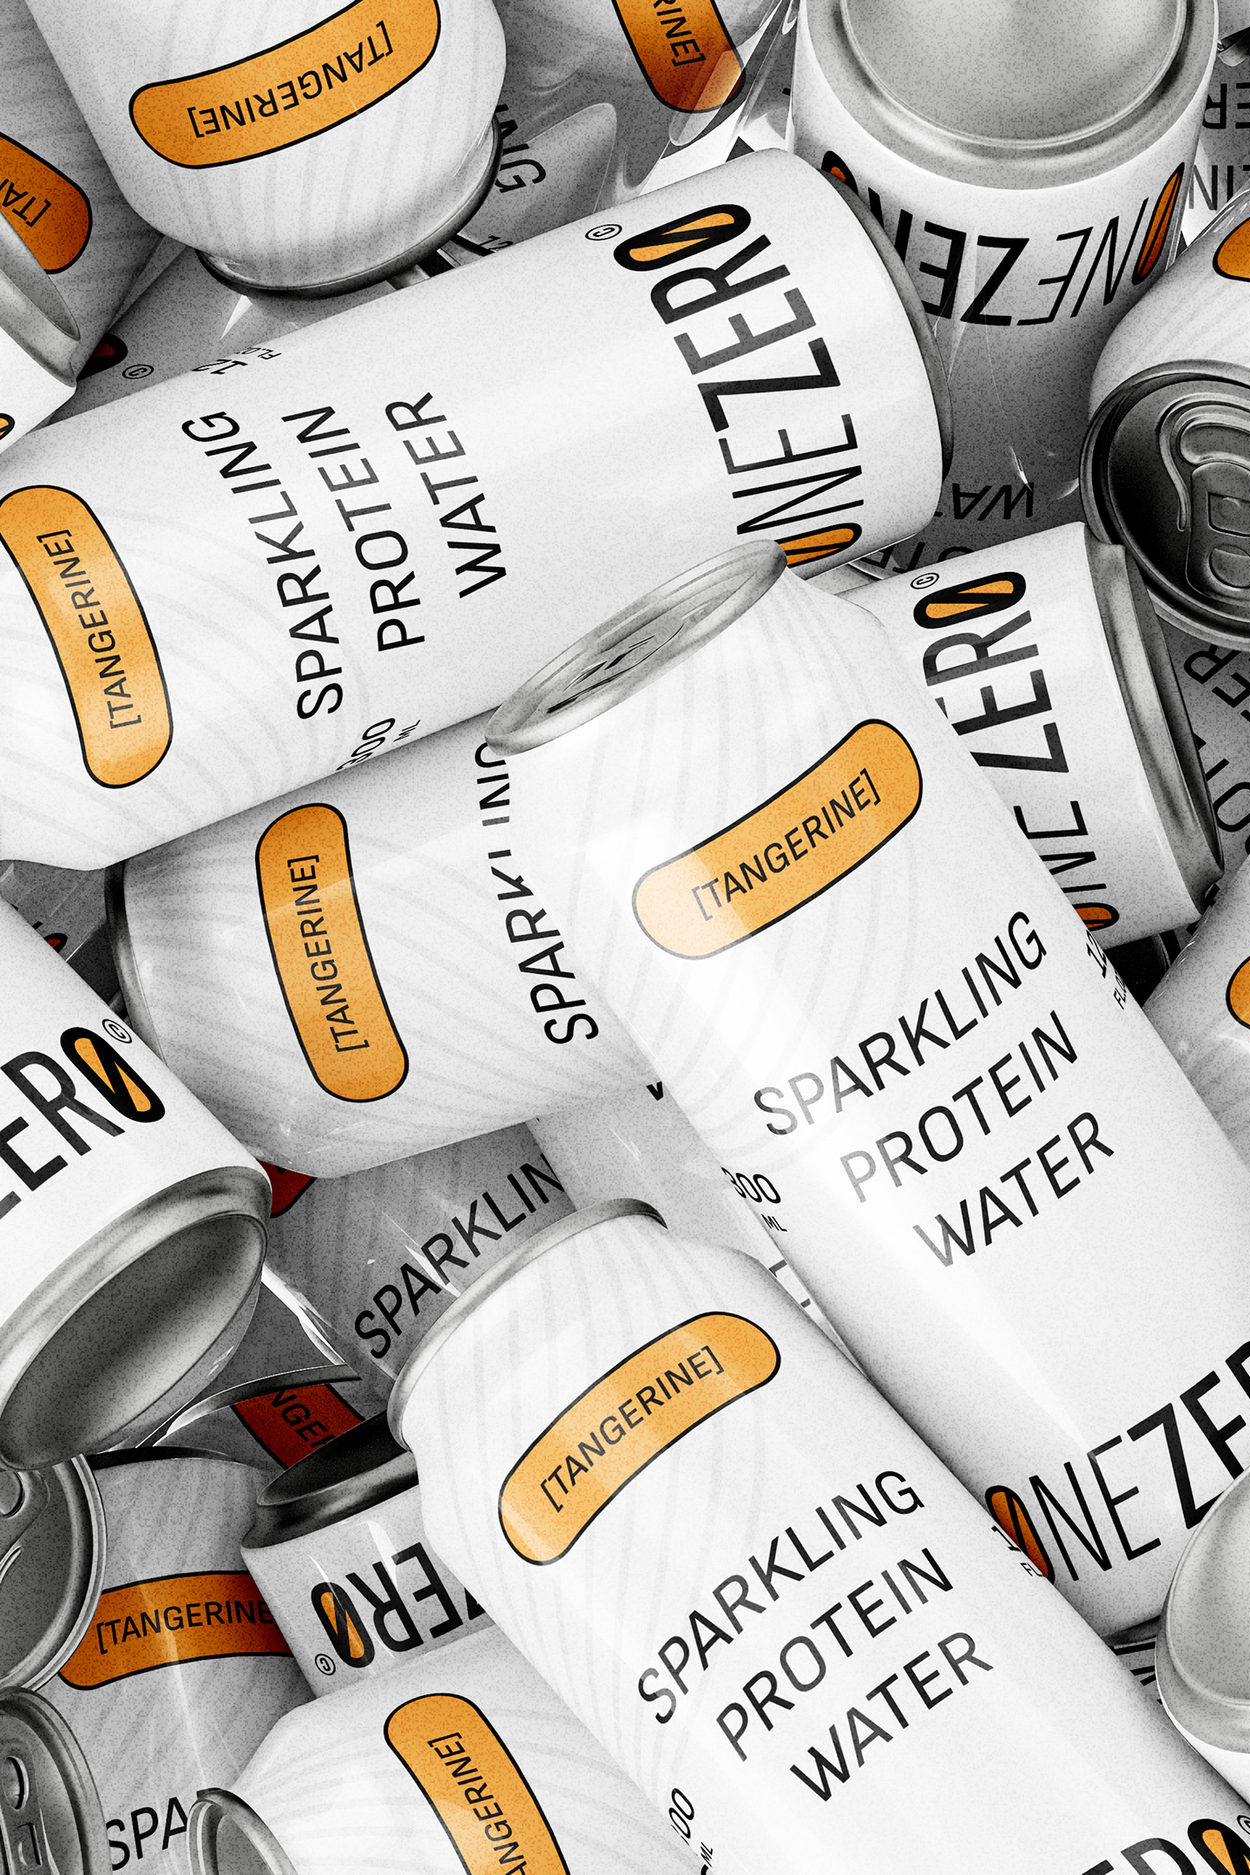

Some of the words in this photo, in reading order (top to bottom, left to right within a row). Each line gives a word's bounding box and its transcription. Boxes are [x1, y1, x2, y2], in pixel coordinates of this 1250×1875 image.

[188, 20, 394, 137] [TANGERINE]
[181, 410, 343, 720] SPARKLING
[281, 405, 425, 651] PROTEIN
[384, 392, 507, 599] WATER
[36, 529, 141, 730] [TANGERINE]
[691, 768, 881, 920] [TANGERINE]
[287, 854, 370, 1053] [TANGERINE]
[753, 910, 1048, 1136] SPARKLING
[839, 1010, 1079, 1203] PROTEIN
[912, 1110, 1115, 1268] WATER
[354, 1154, 566, 1360] SPARKLIN
[761, 1213, 788, 1233] ML
[540, 1345, 724, 1513] [TANGERINE]
[97, 1600, 276, 1655] [TANGERINE
[637, 1469, 925, 1725] SPARKLING
[715, 1547, 955, 1762] PROTEIN
[427, 1732, 530, 1875] ANGERINE]
[789, 1630, 994, 1803] WATER
[669, 1786, 696, 1845] 00
